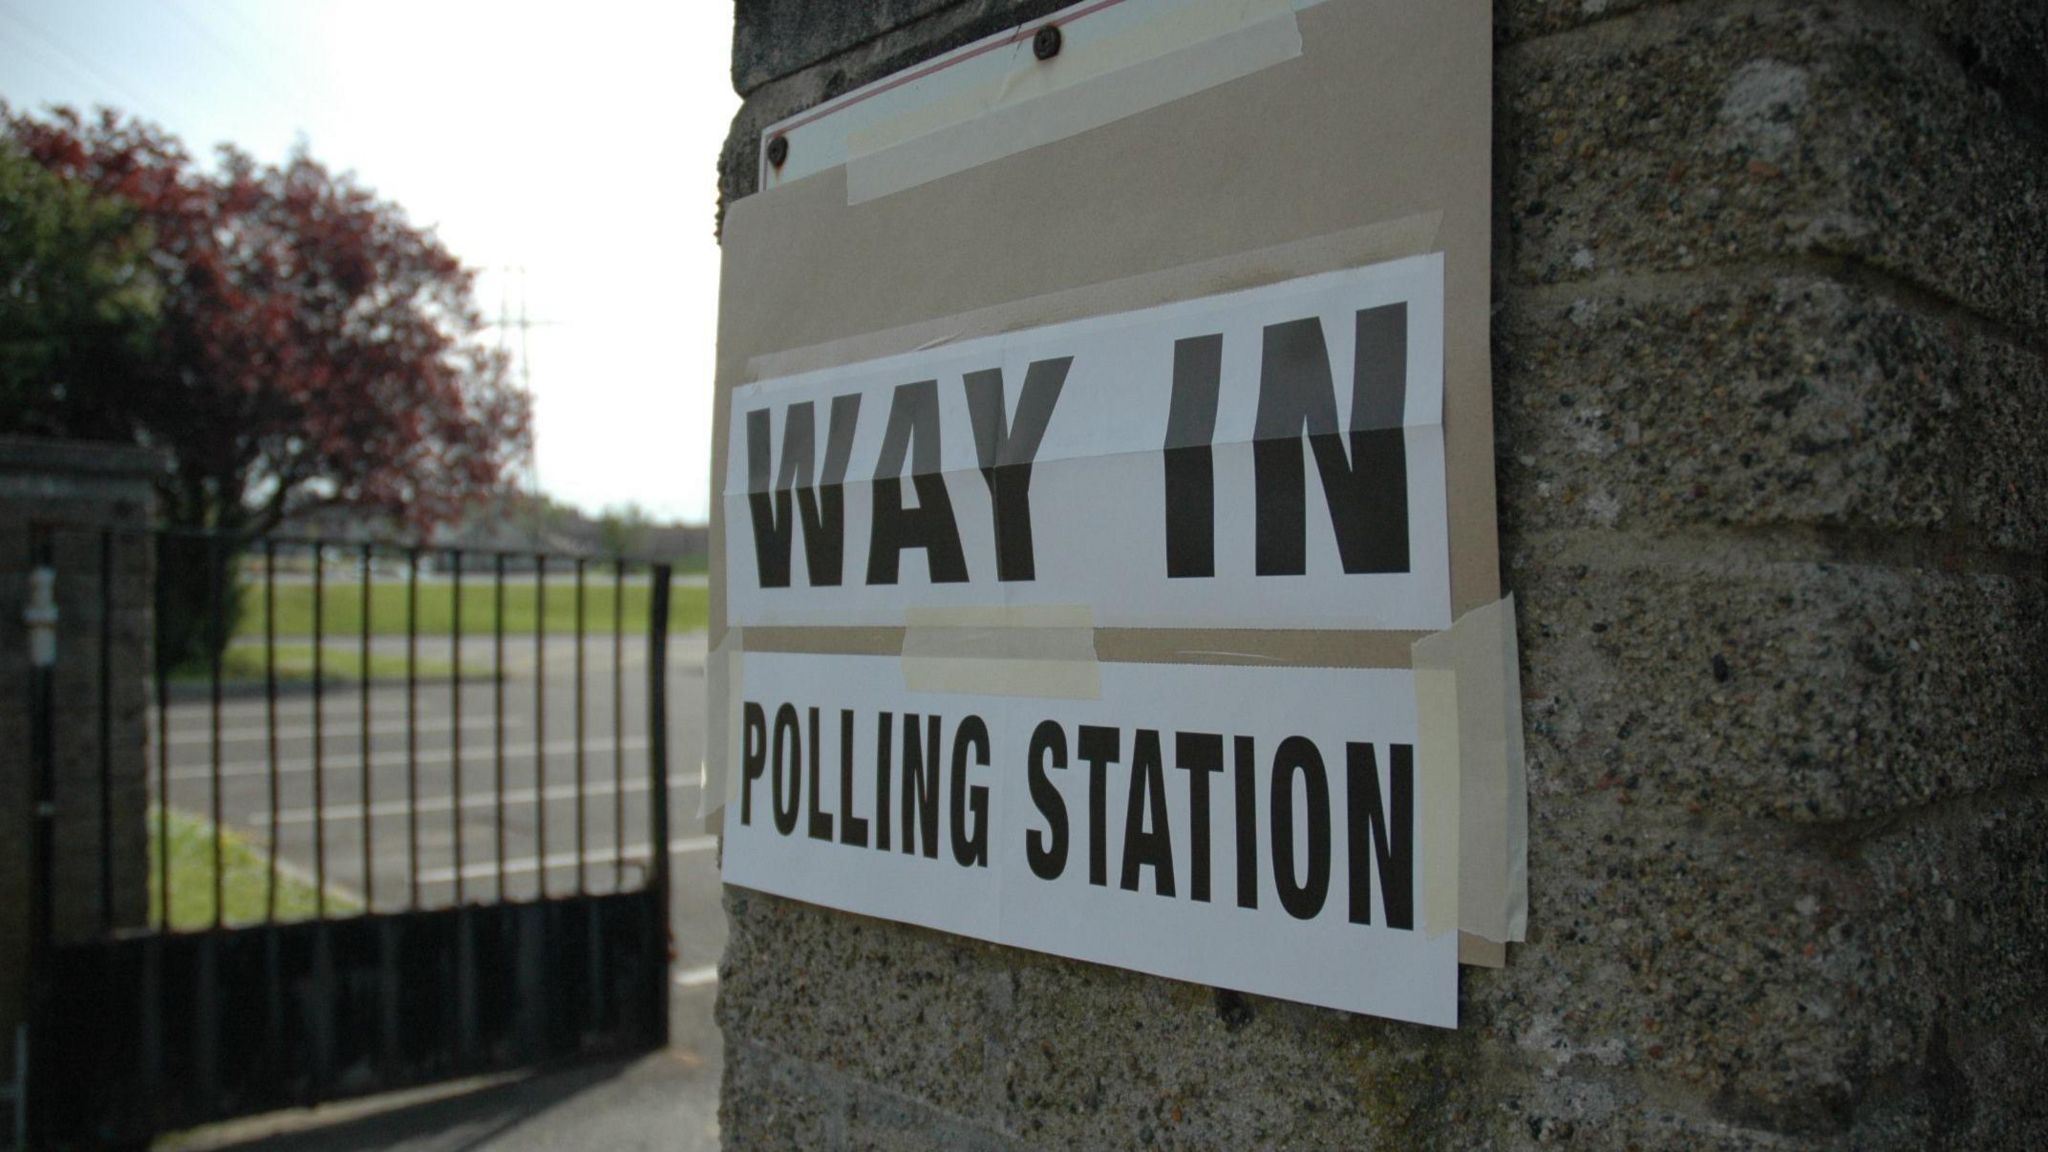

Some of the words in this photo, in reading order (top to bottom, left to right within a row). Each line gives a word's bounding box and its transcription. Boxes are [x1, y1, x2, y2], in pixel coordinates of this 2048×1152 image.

[746, 355, 1074, 590] WAY
[1162, 301, 1411, 578] IN
[740, 701, 991, 868] POLLING
[1025, 719, 1415, 932] STATION
